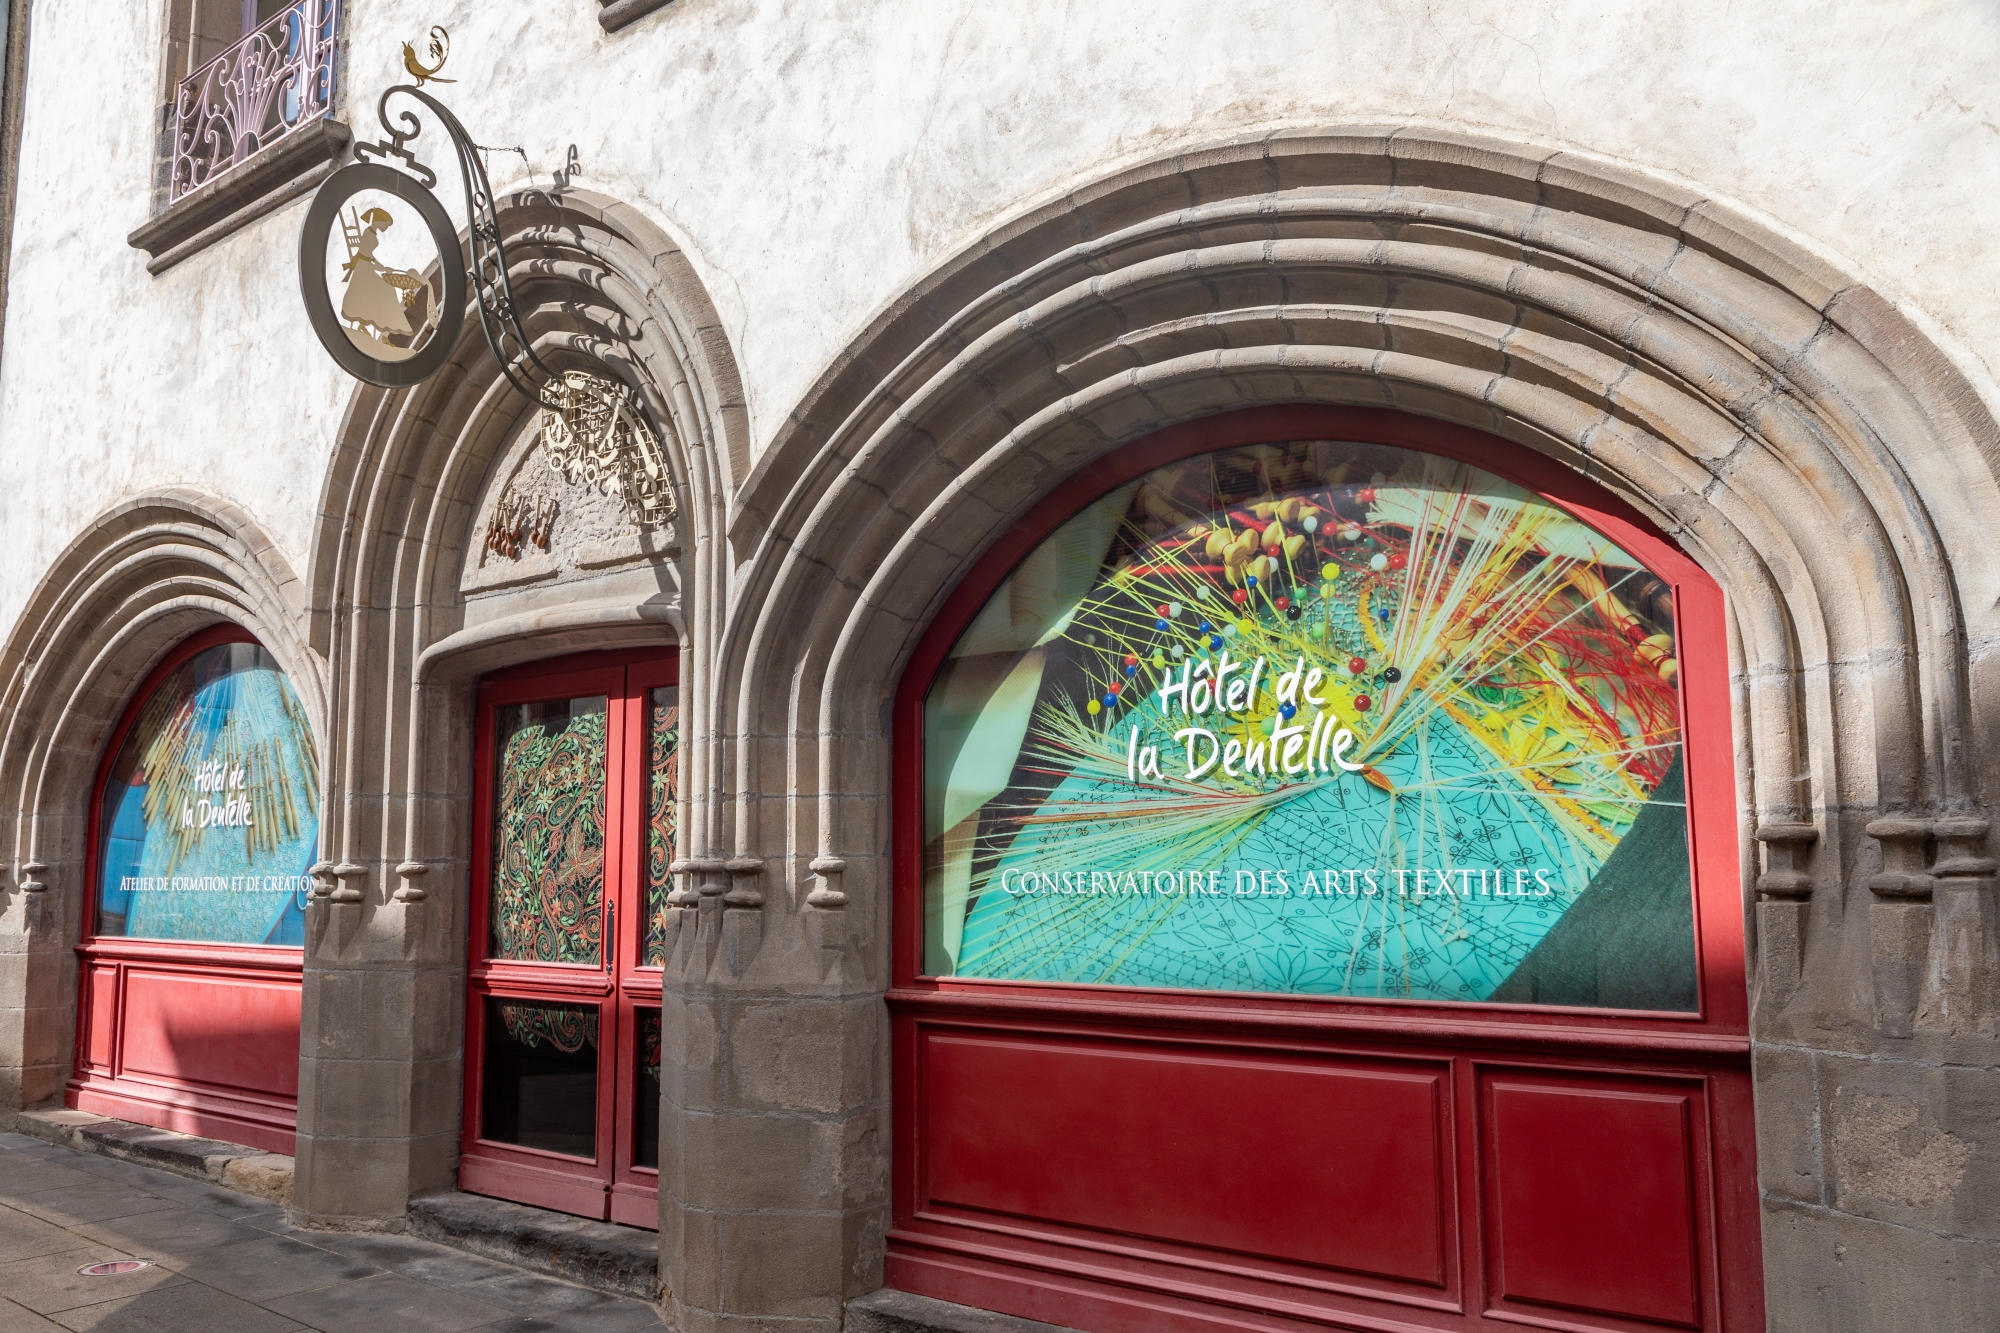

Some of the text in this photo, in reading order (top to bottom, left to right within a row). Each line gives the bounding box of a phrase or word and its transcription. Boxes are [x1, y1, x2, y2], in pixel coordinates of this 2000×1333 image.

[1158, 651, 1326, 715] Hôtel de
[1127, 711, 1364, 781] la Dentelle
[194, 758, 245, 792] Hôtel de
[182, 793, 253, 829] la Dentelle
[119, 875, 154, 891] ATELIER
[156, 877, 169, 891] DE
[171, 876, 228, 891] FORMATION
[232, 876, 244, 891] ET
[246, 876, 260, 891] DE
[1001, 868, 1551, 896] CONSERVATOIRE DES ARTS TEXTILES
